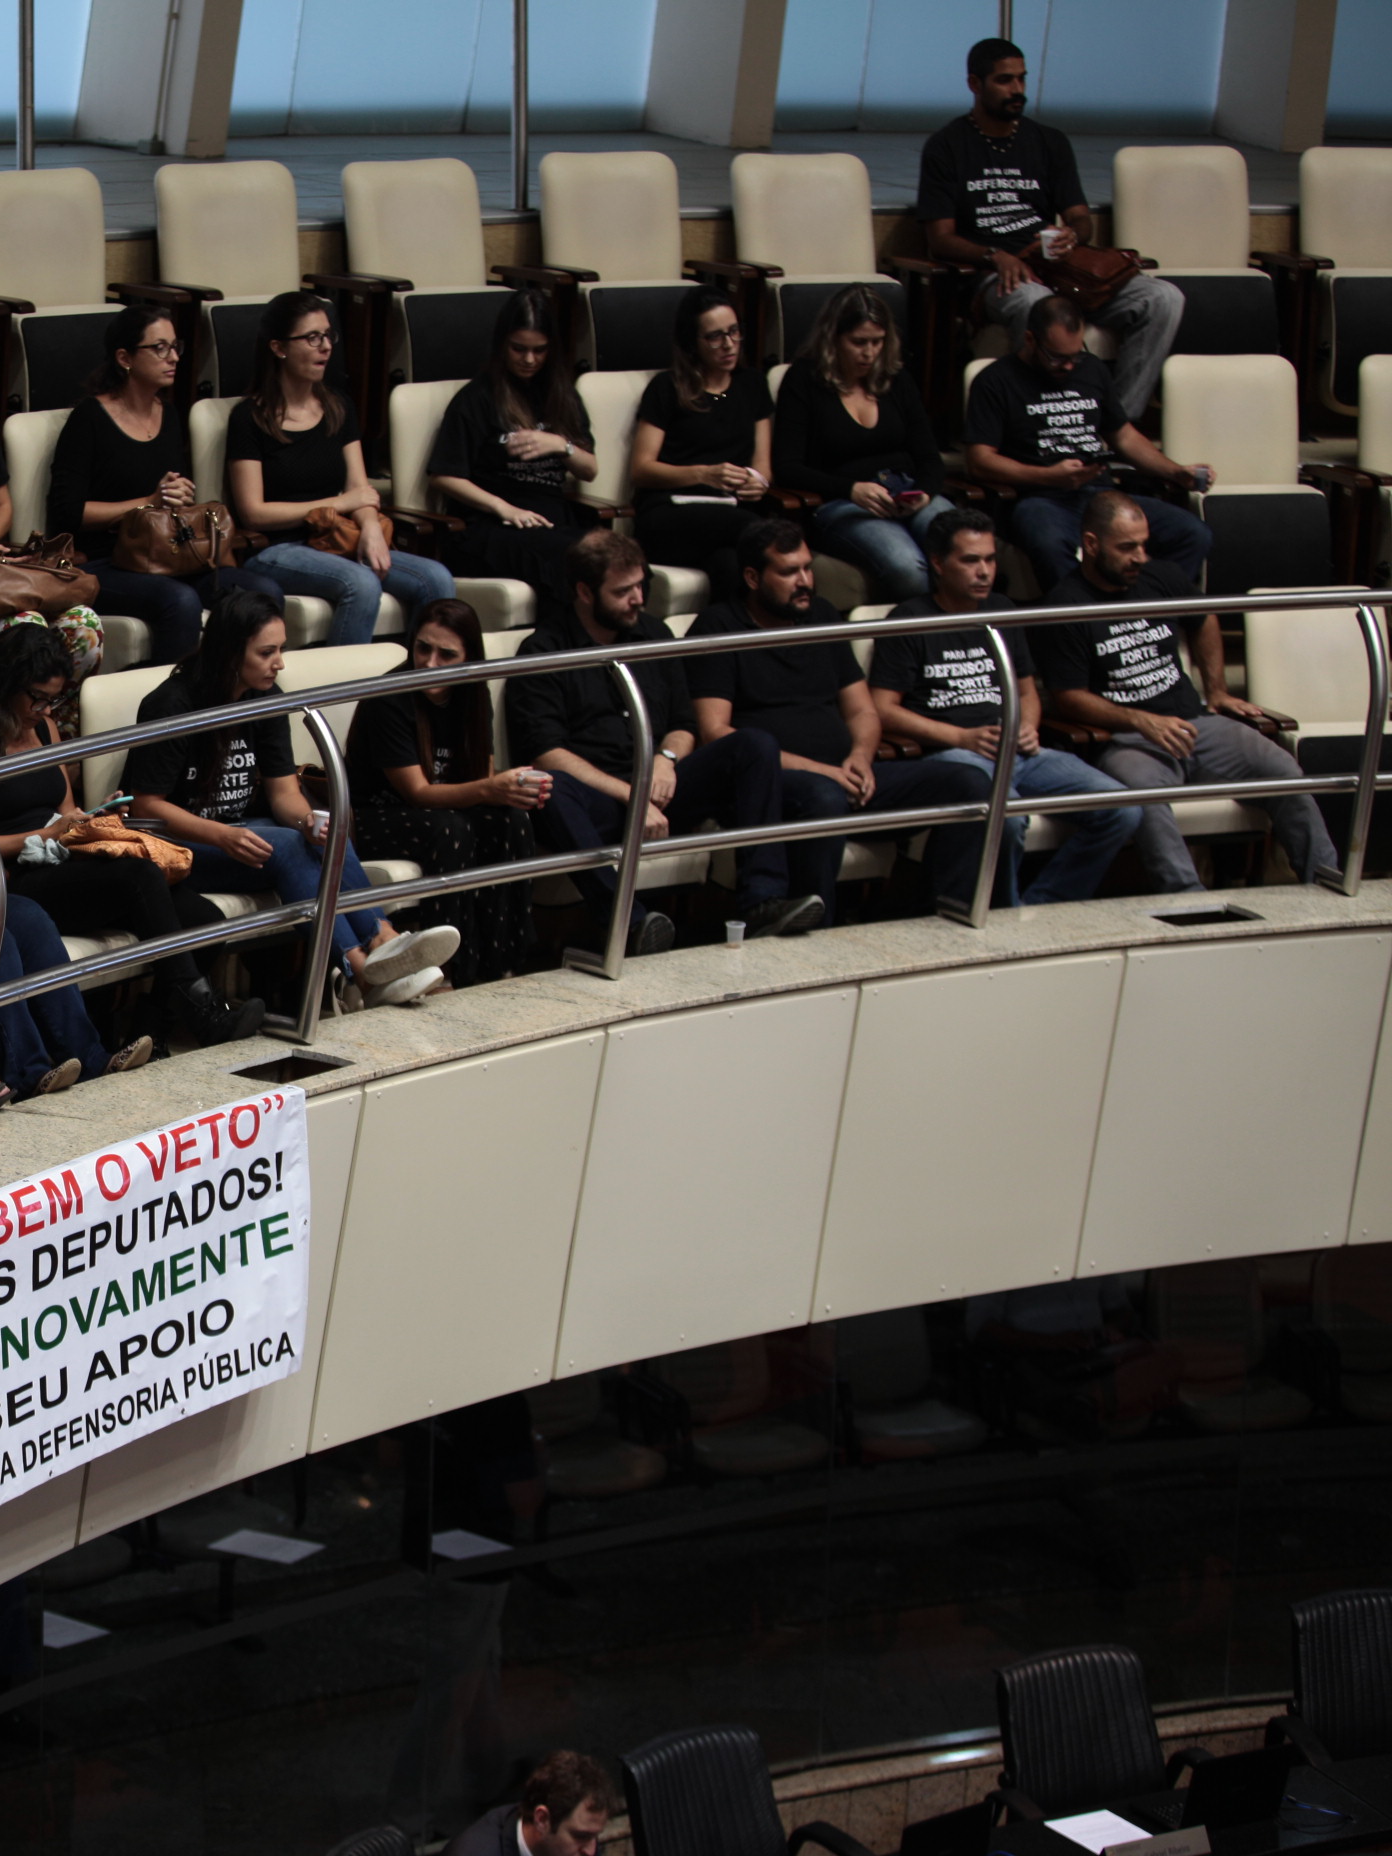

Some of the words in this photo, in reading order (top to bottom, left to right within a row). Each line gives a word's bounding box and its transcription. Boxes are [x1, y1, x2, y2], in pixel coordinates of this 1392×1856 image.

[1026, 398, 1098, 415] DEFENSORIA
[1047, 413, 1085, 426] FORTE
[1096, 624, 1173, 656] DEFENSORIA
[924, 658, 996, 678] DEFENSOR
[1120, 644, 1159, 666] FORTE
[230, 739, 248, 750] MA
[219, 772, 249, 788] RTE
[95, 1153, 131, 1201] O
[32, 1151, 283, 1292] DEPUTADOS!
[0, 1211, 294, 1370] NOVAMENTE
[84, 1299, 235, 1393] APOIO
[21, 1377, 178, 1474] DEFENSORIA
[183, 1331, 295, 1399] PÚBLICA
